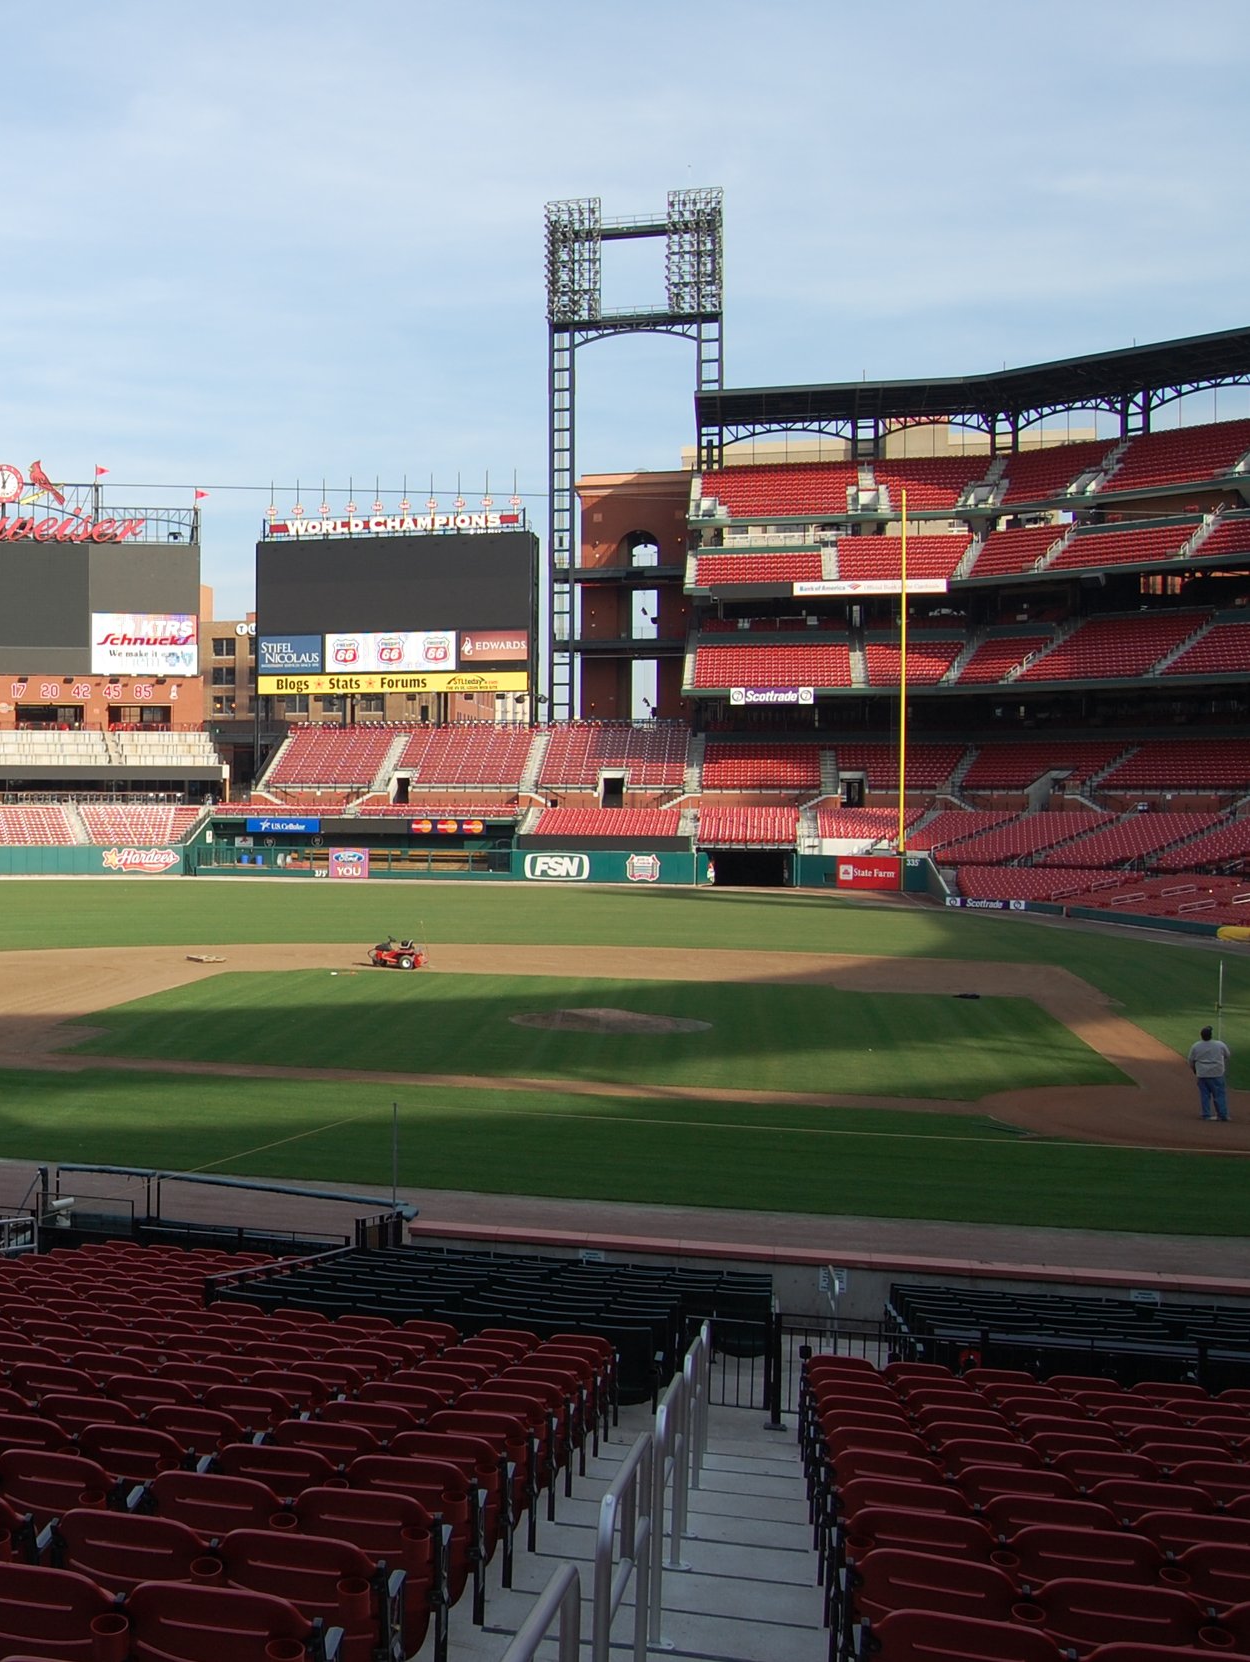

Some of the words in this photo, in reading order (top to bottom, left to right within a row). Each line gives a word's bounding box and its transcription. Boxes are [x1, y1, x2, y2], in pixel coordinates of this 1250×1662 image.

[286, 519, 364, 535] WORLD
[369, 513, 501, 532] CHAMPIONS
[96, 633, 195, 645] Schnucks
[261, 642, 293, 653] STIFEL
[475, 641, 525, 650] EDWARDS
[109, 649, 122, 657] We
[125, 649, 148, 657] make
[265, 652, 319, 664] NICOLAUS
[336, 649, 355, 661] 66
[381, 648, 400, 660] 66
[426, 647, 445, 659] 66
[276, 678, 309, 692] Blogs
[329, 677, 361, 690] Stats
[380, 677, 427, 688] Forums
[11, 683, 27, 698] 17
[40, 684, 59, 698] 20
[72, 684, 91, 698] 42
[103, 684, 121, 699] 45
[134, 685, 153, 699] 85
[746, 690, 798, 702] Scottrade
[281, 822, 305, 830] Cellular
[337, 867, 361, 876] YOU
[534, 857, 579, 876] FSN
[853, 868, 872, 877] State
[874, 869, 895, 878] Farm
[966, 898, 1004, 909] Scottrade
